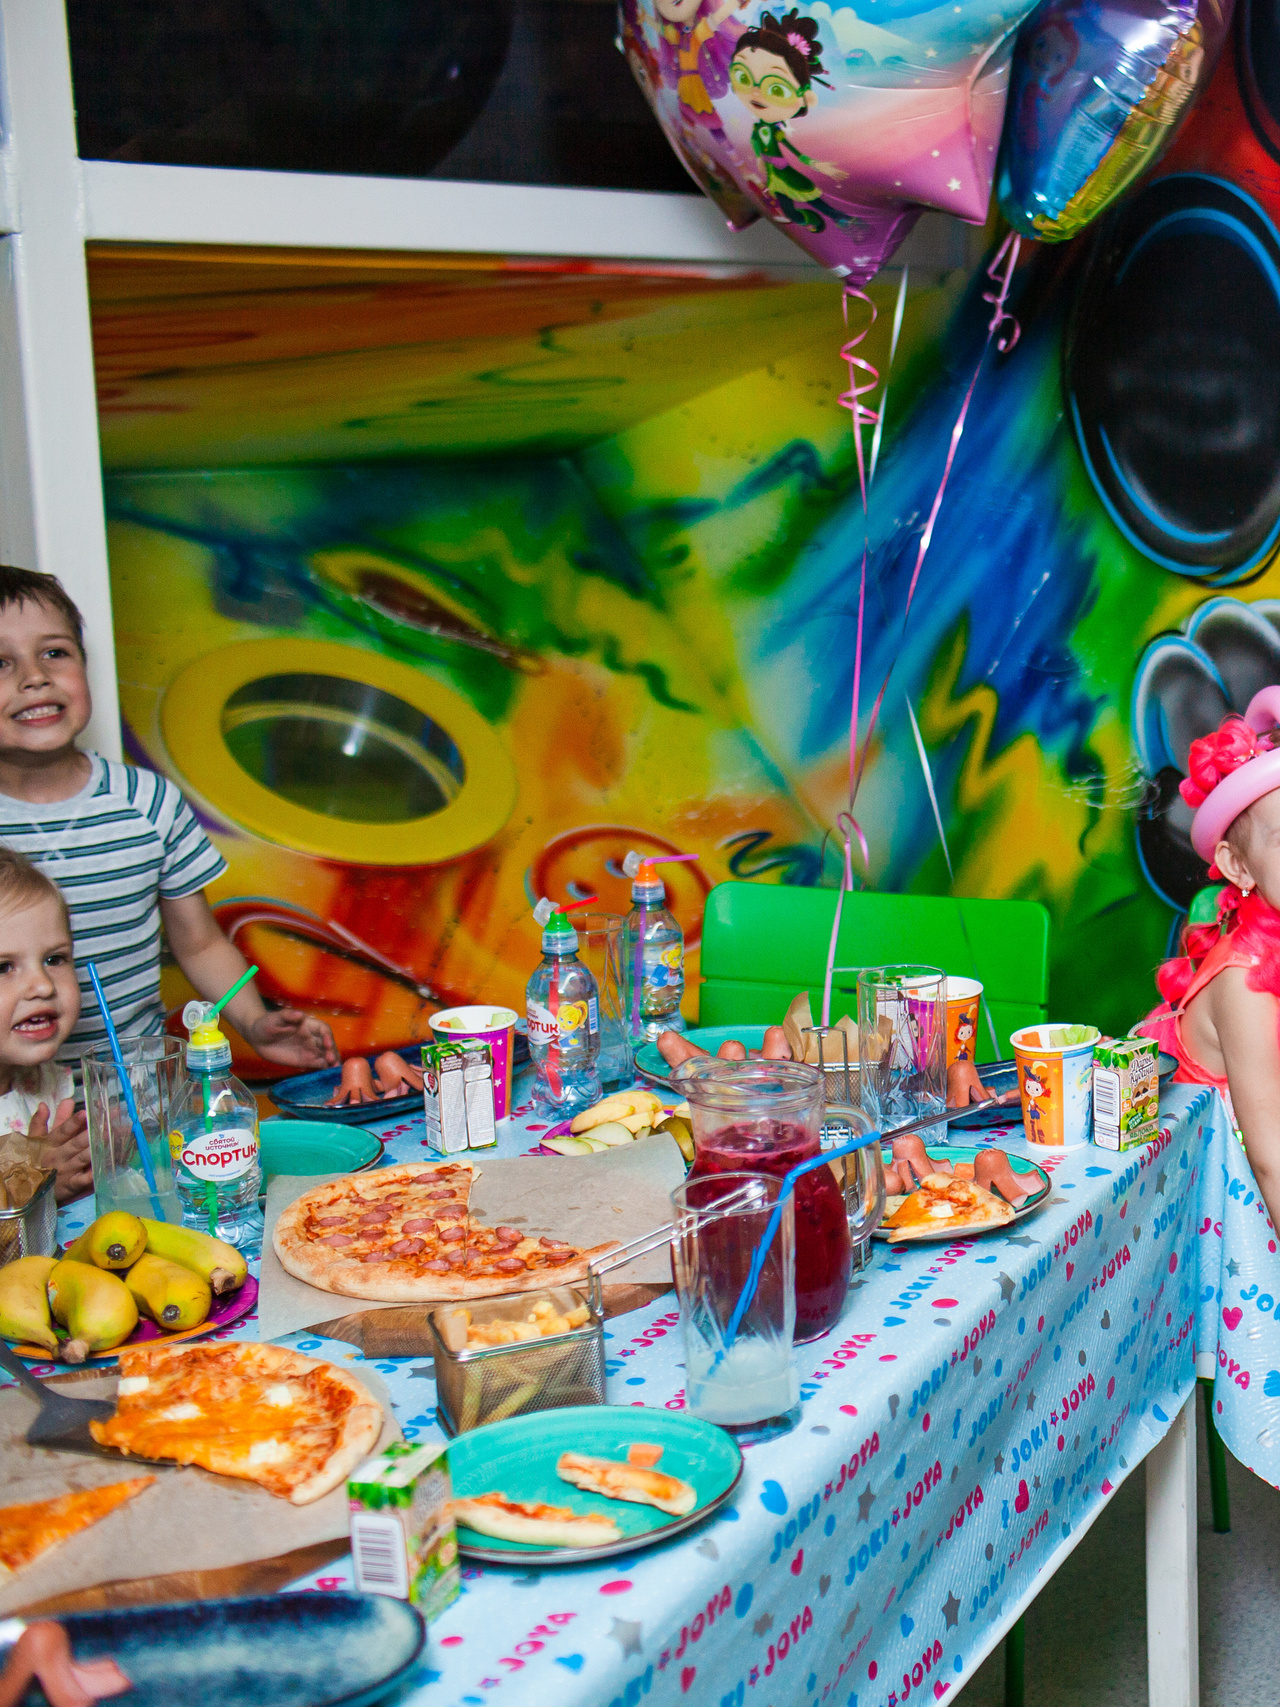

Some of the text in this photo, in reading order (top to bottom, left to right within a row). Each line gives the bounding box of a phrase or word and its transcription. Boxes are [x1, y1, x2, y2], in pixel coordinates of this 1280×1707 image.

[182, 1142, 257, 1168] Спортик
[1112, 1128, 1172, 1204] JOKI JOYA
[1019, 1209, 1093, 1301] JOKI JOYA
[1100, 1244, 1131, 1287] JOYA
[890, 1275, 938, 1310] JOKI
[822, 1334, 877, 1369] JOYA
[908, 1309, 996, 1419] JOKI JOYA
[969, 1392, 1004, 1447] JOKI
[1011, 1373, 1095, 1473] JOKI JOYA
[770, 1431, 880, 1564] JOKI JOYA
[845, 1460, 942, 1586] JOKI JOYA
[946, 1484, 984, 1540] JOYA
[970, 1509, 1049, 1622] JOKI JOYA
[498, 1613, 578, 1672] JOYA
[674, 1585, 733, 1660] JOYA
[764, 1605, 813, 1677] JOYA
[901, 1640, 943, 1701] JOYA
